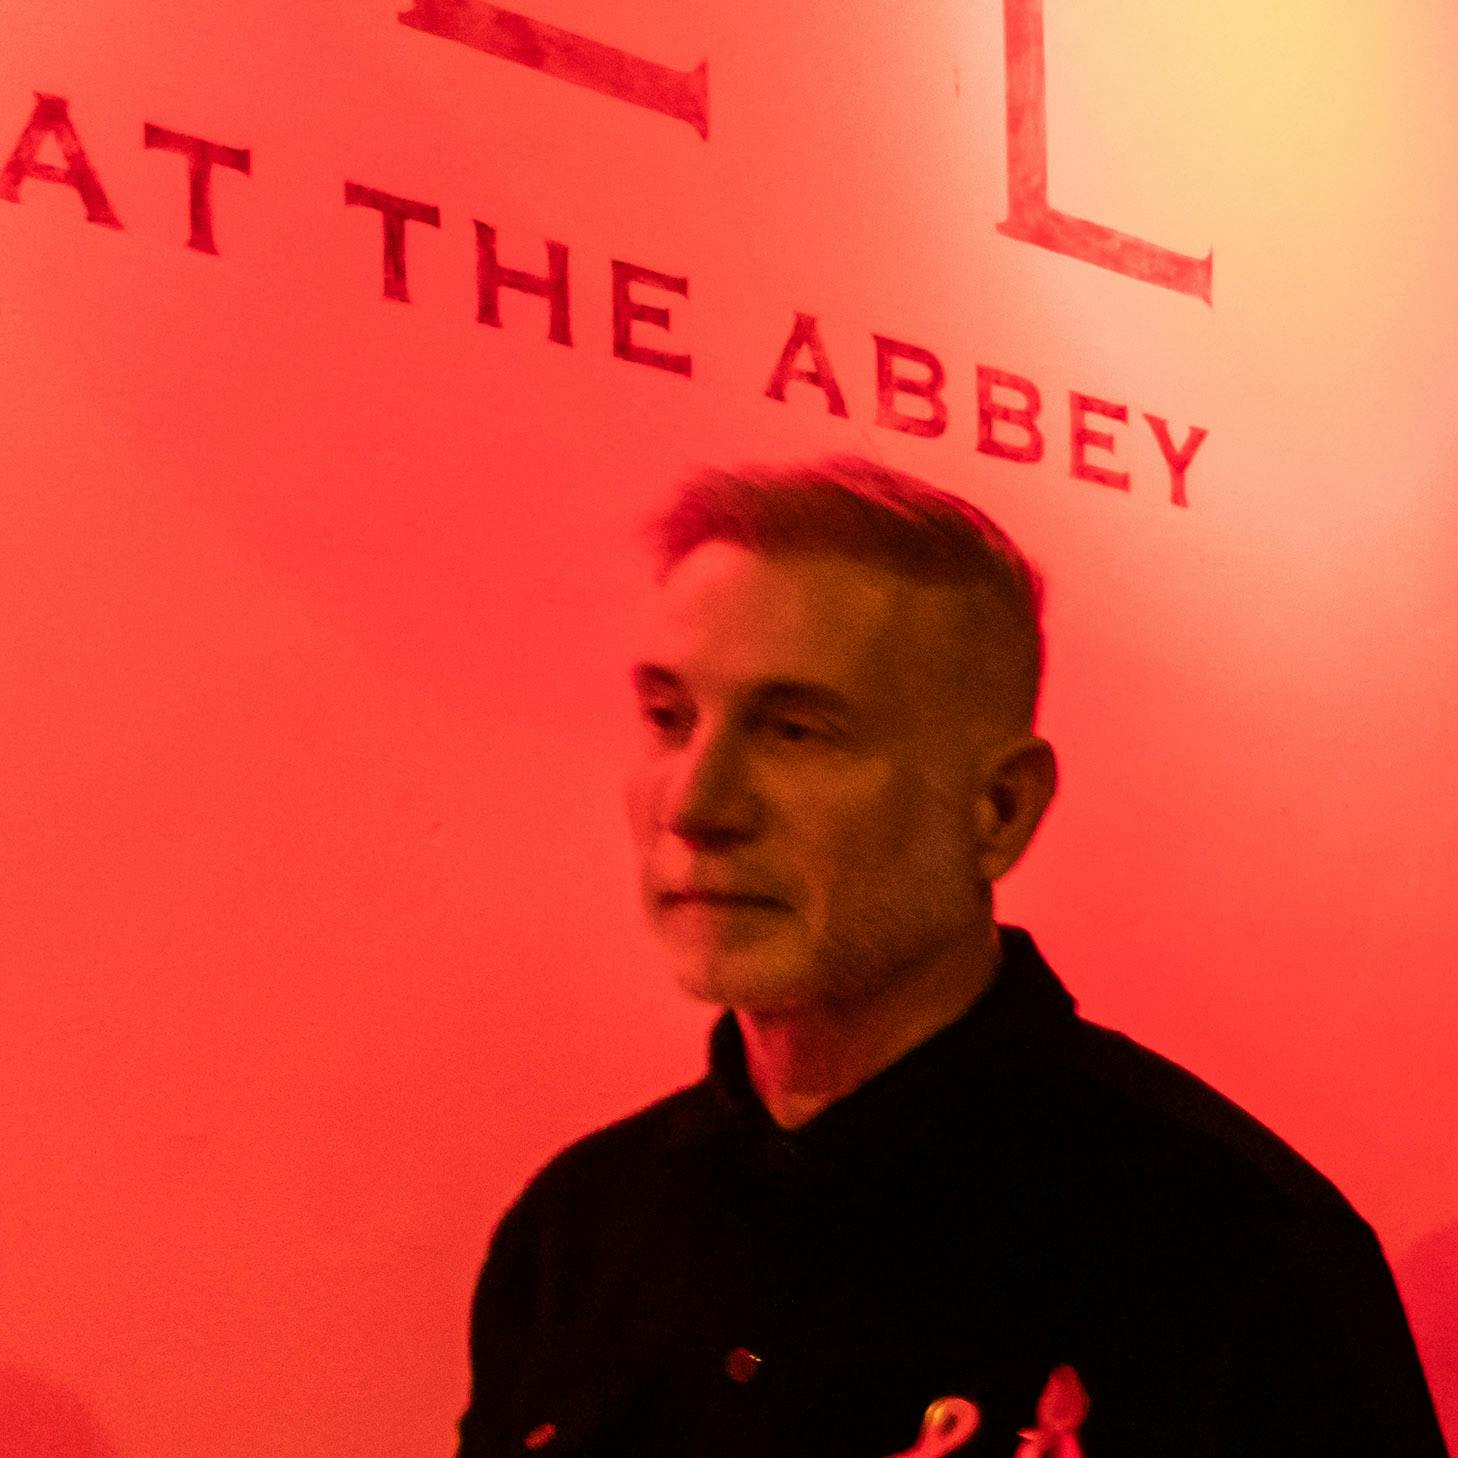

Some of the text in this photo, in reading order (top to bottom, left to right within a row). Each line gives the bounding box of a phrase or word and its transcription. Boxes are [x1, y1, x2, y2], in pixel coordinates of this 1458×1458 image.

[0, 91, 1209, 508] AT THE ABBEY
